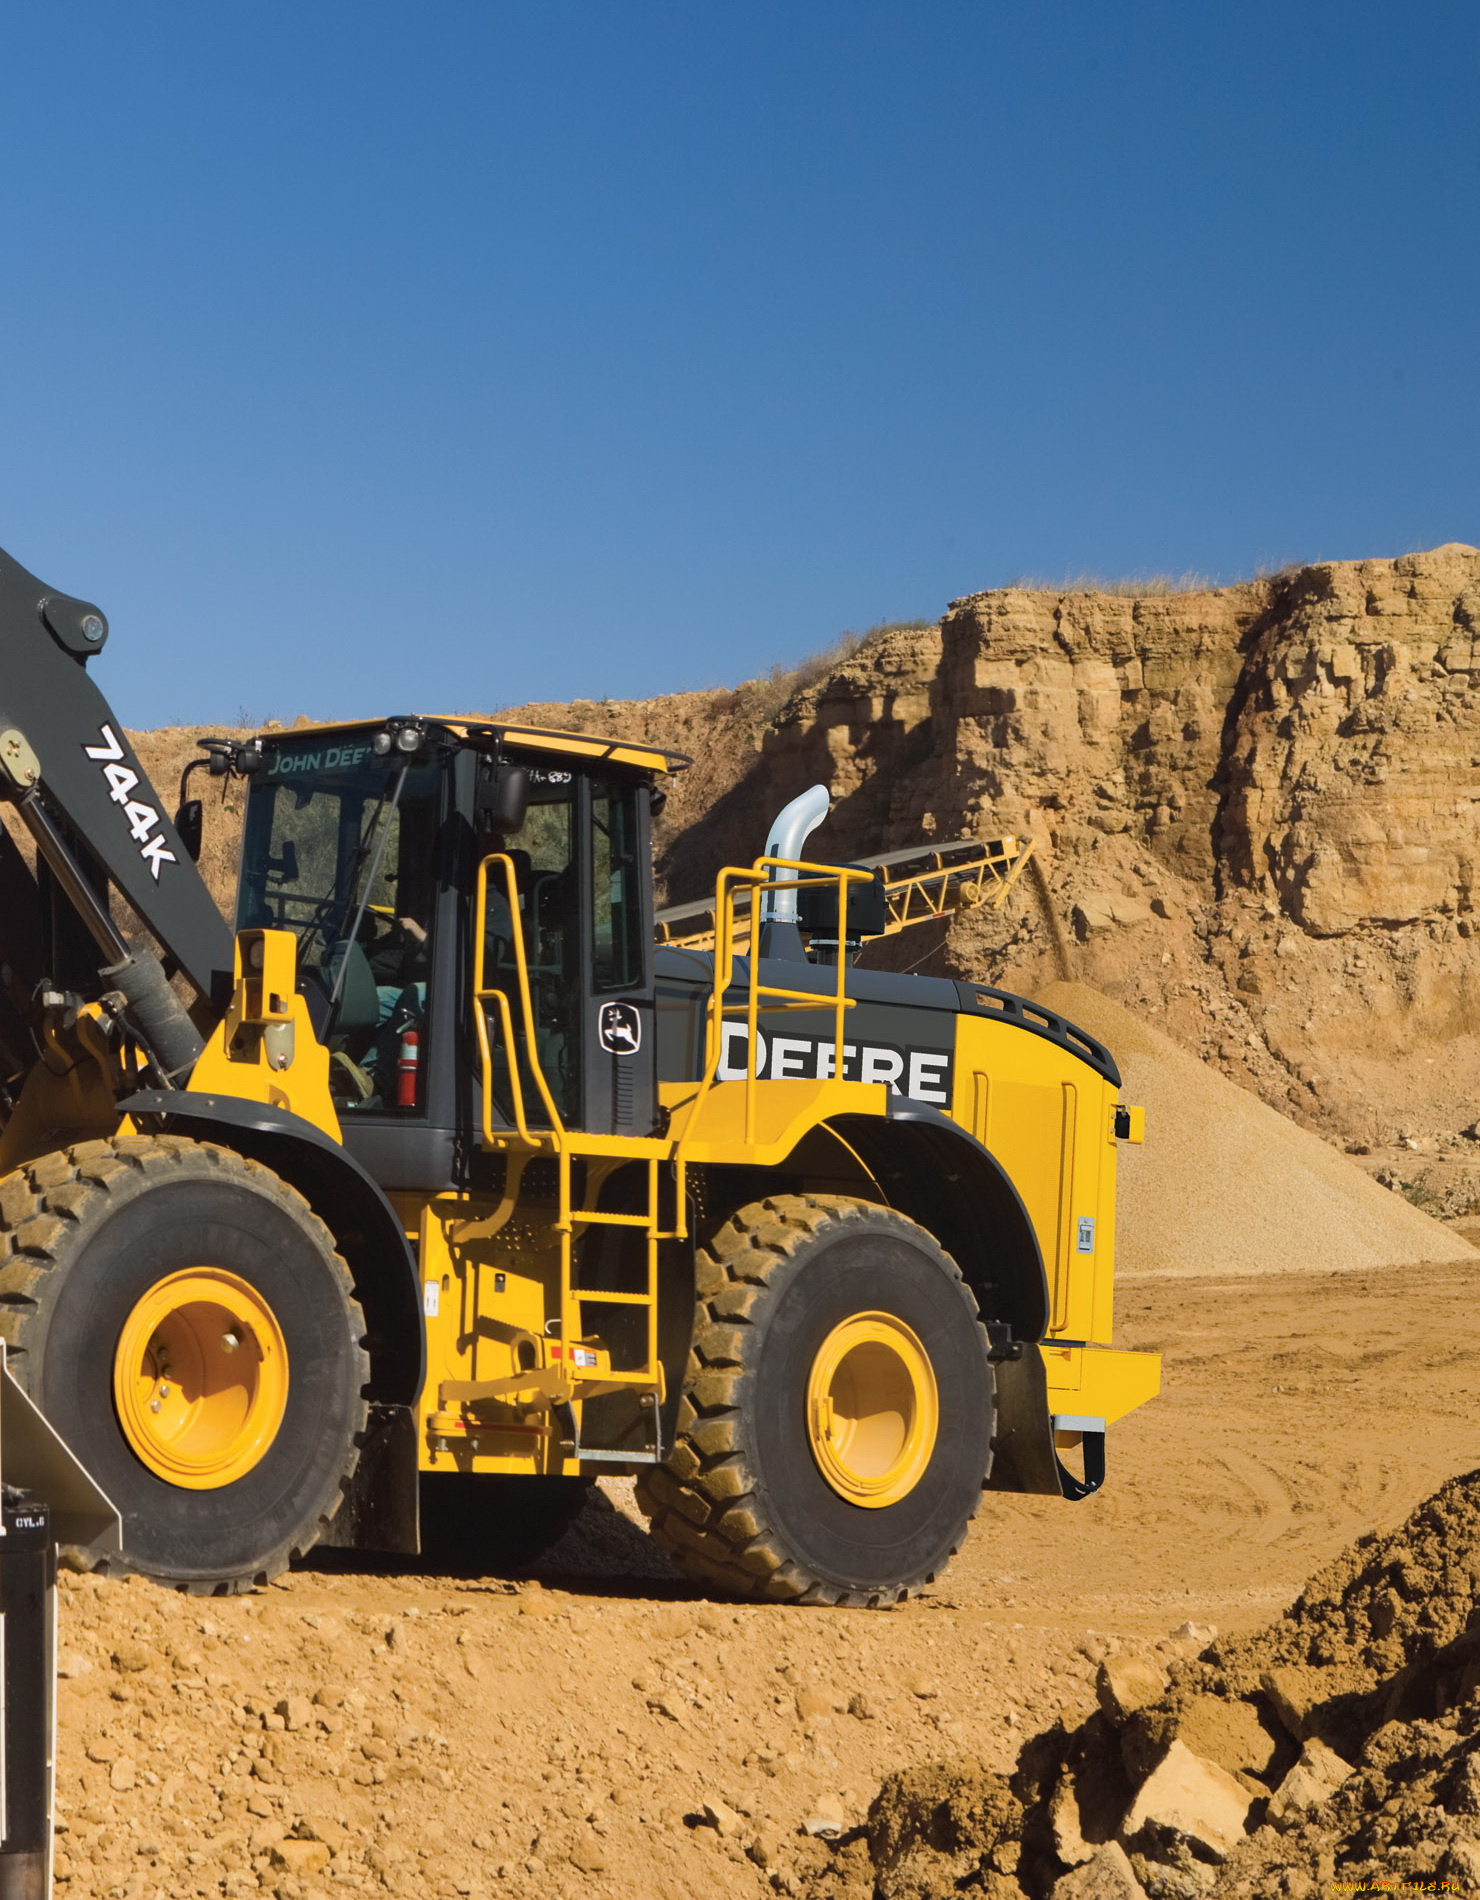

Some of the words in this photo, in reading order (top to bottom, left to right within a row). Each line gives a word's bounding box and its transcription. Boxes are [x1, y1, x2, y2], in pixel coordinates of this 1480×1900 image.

[85, 724, 177, 880] 744K
[268, 753, 321, 775] JOHN
[716, 1021, 949, 1103] DEERE
